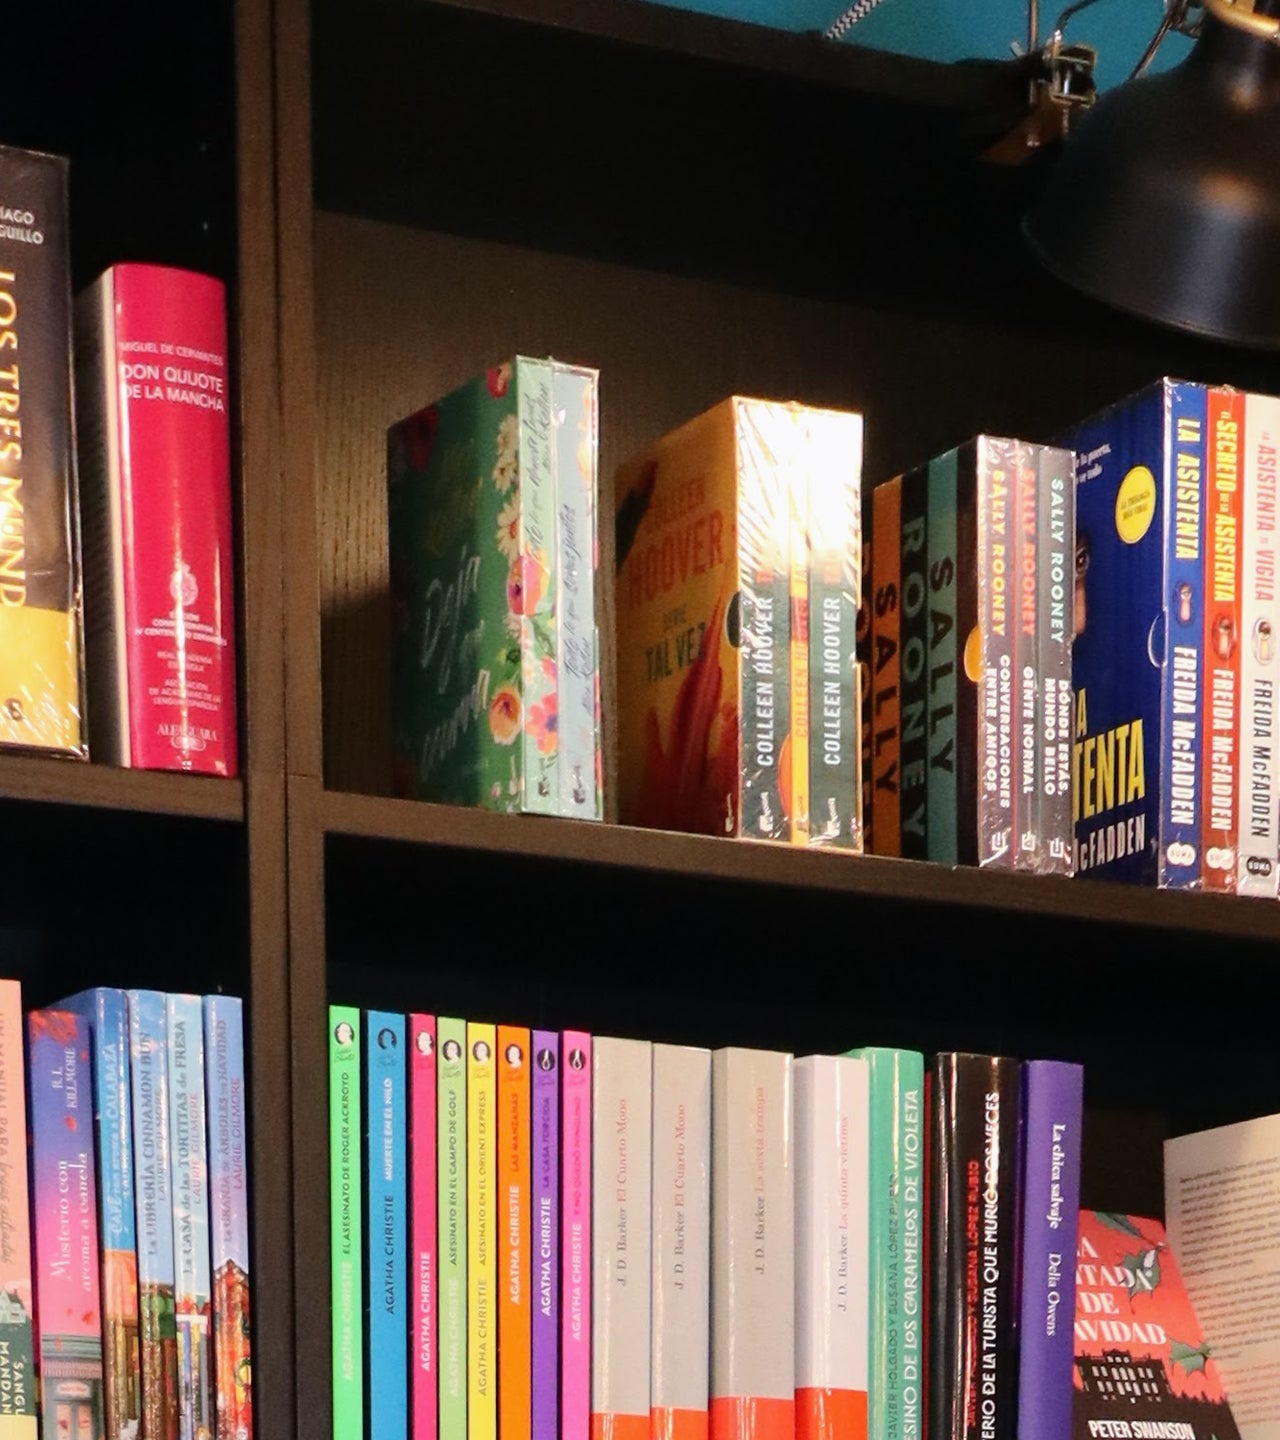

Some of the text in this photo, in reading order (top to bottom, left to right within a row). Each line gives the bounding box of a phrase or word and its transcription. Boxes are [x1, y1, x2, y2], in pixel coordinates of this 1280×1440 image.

[1176, 418, 1200, 560] LA ASISTENTA
[1050, 479, 1063, 643] SALLY ROONEY
[1173, 646, 1197, 721] FREIDA
[905, 1089, 920, 1177] VIOLETA
[905, 1179, 919, 1206] DE
[1046, 1124, 1067, 1337] La chica salvaje Delia Owens
[420, 1252, 432, 1371] AGATHA CHRISTIE
[905, 1319, 917, 1350] LOS
[904, 1356, 917, 1378] DE
[1088, 1419, 1130, 1440] PETER
